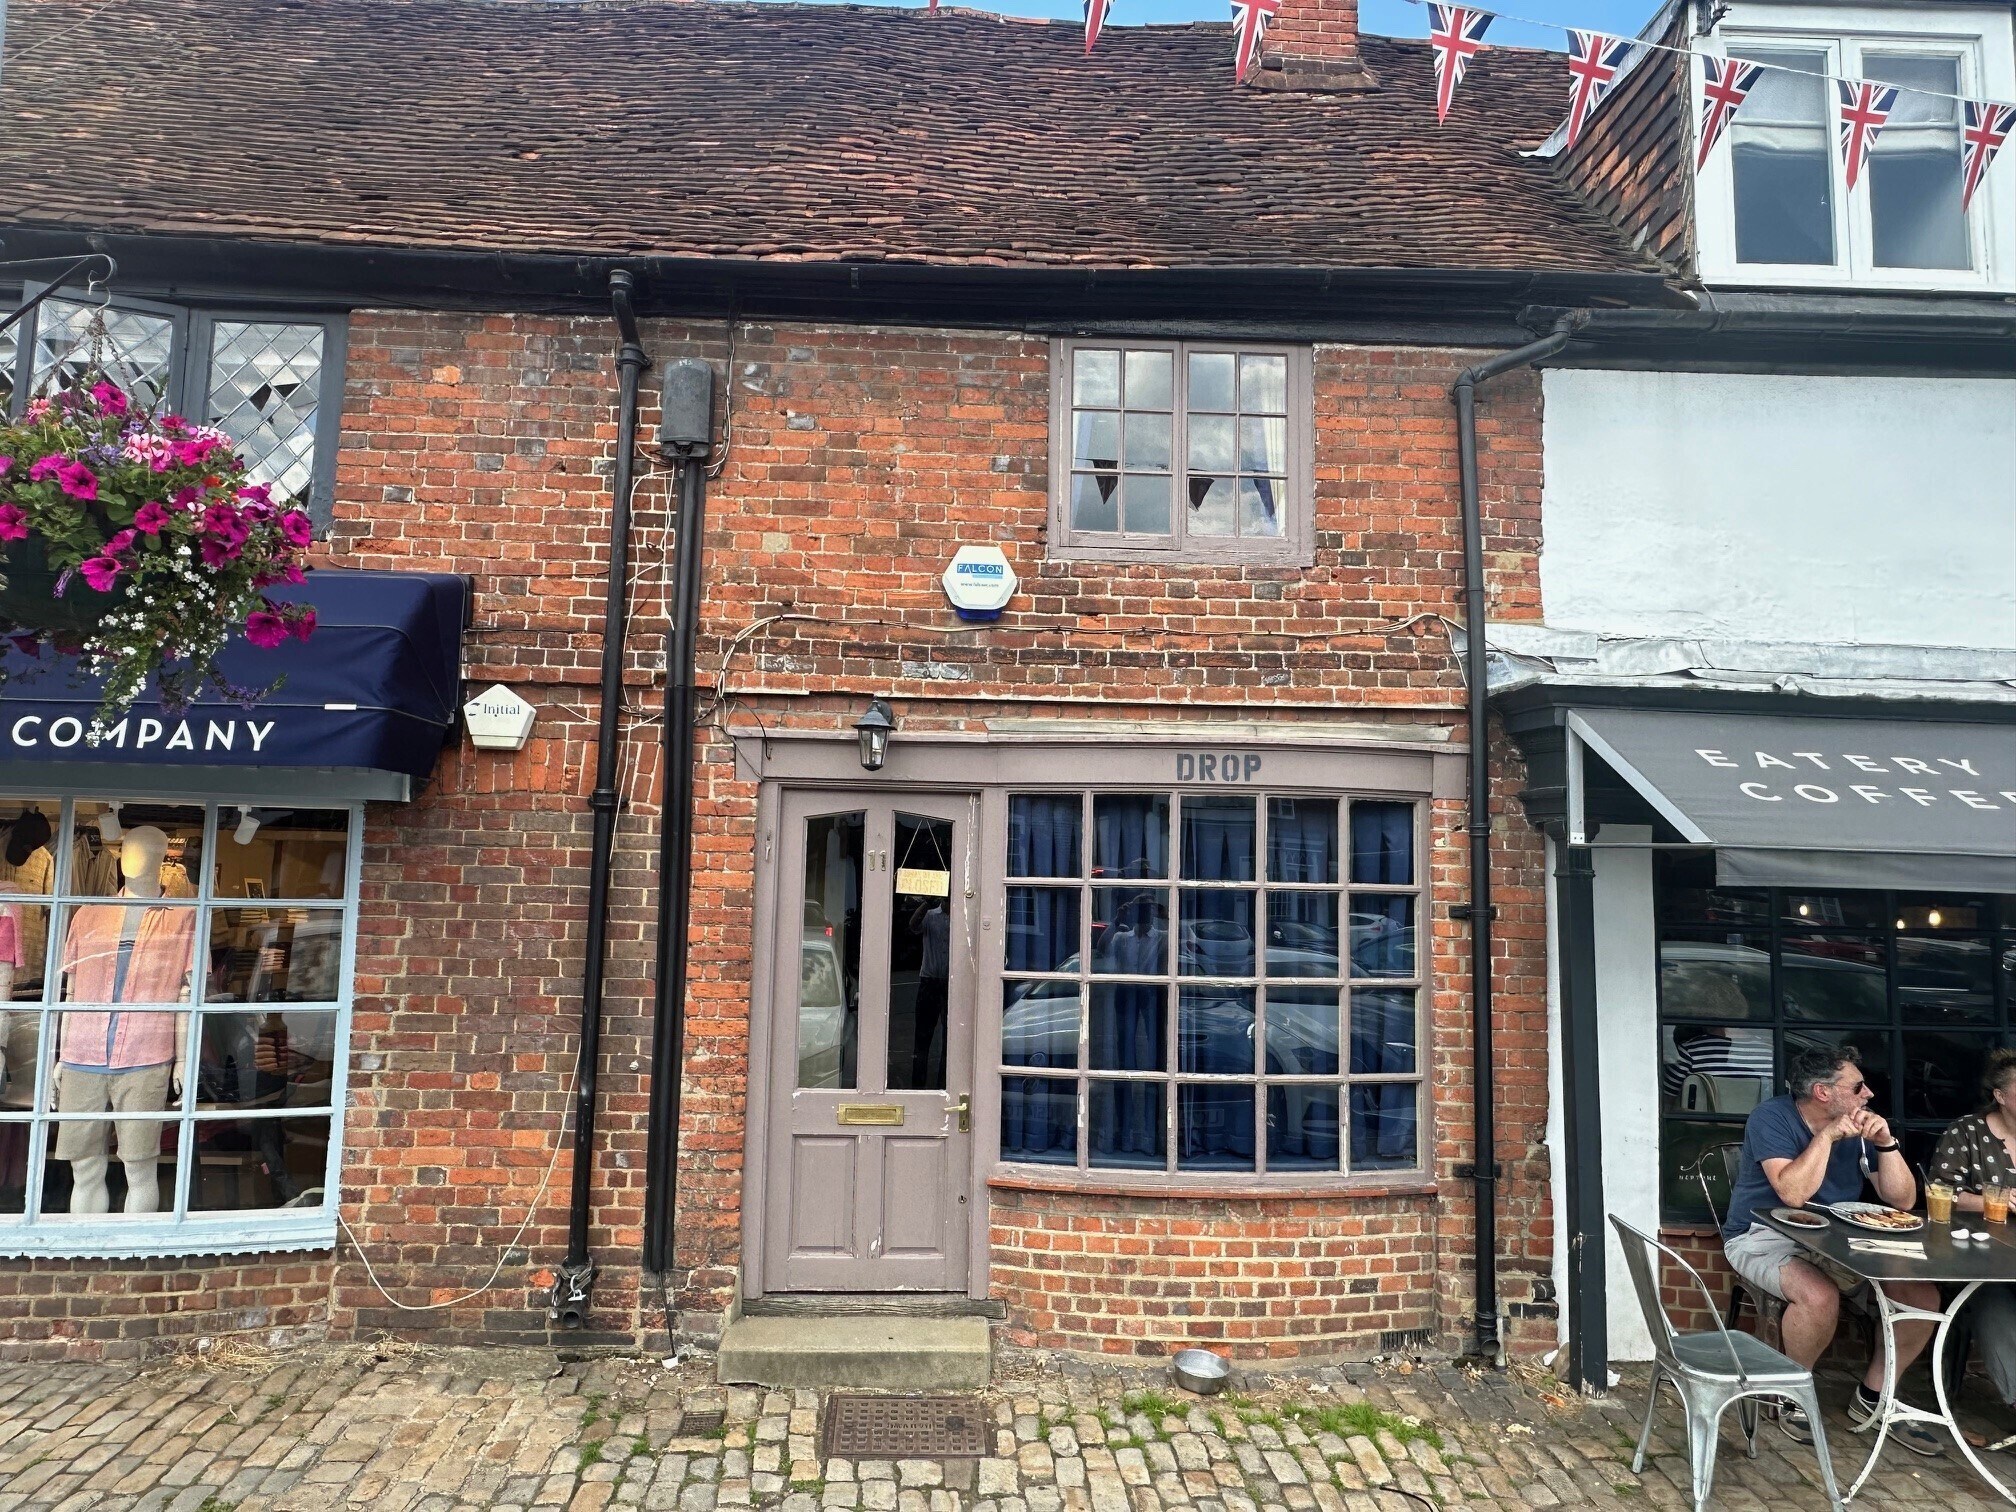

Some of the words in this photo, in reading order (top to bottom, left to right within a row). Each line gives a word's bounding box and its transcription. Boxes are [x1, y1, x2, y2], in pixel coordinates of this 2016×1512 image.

[957, 564, 1003, 574] FALCON
[483, 703, 520, 715] Initial
[1176, 753, 1262, 782] DROP
[1694, 749, 1981, 776] EATERY
